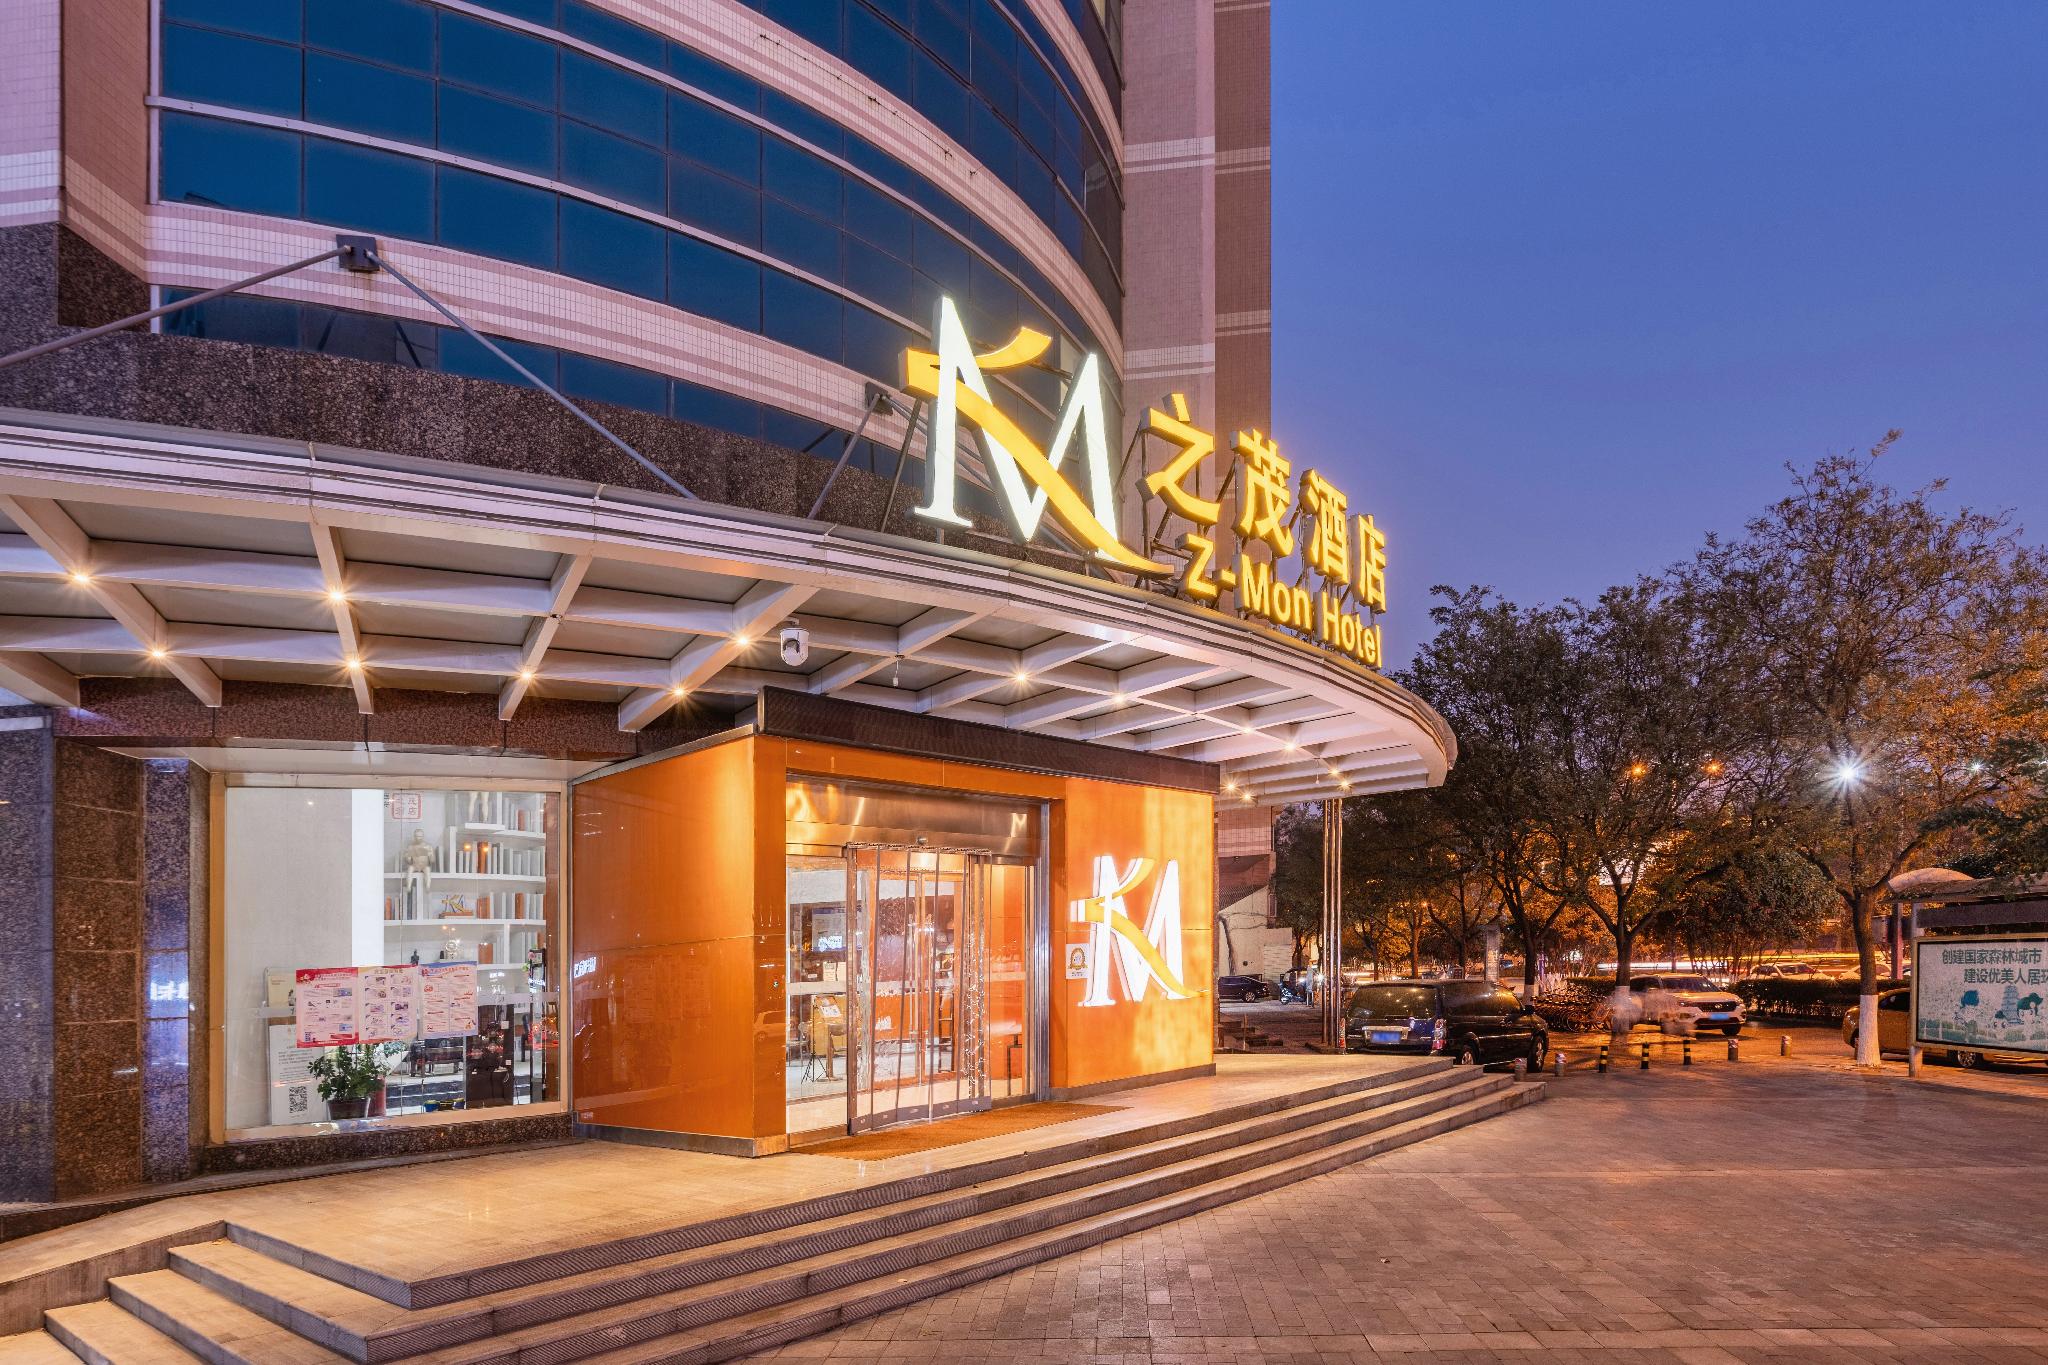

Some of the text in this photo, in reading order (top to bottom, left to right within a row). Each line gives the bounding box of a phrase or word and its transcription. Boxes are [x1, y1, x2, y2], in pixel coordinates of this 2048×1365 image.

[1139, 393, 1386, 613] 之茂酒店
[1177, 534, 1382, 668] Z-Mon Hotel
[1942, 948, 2042, 964] 创建国家森林城市
